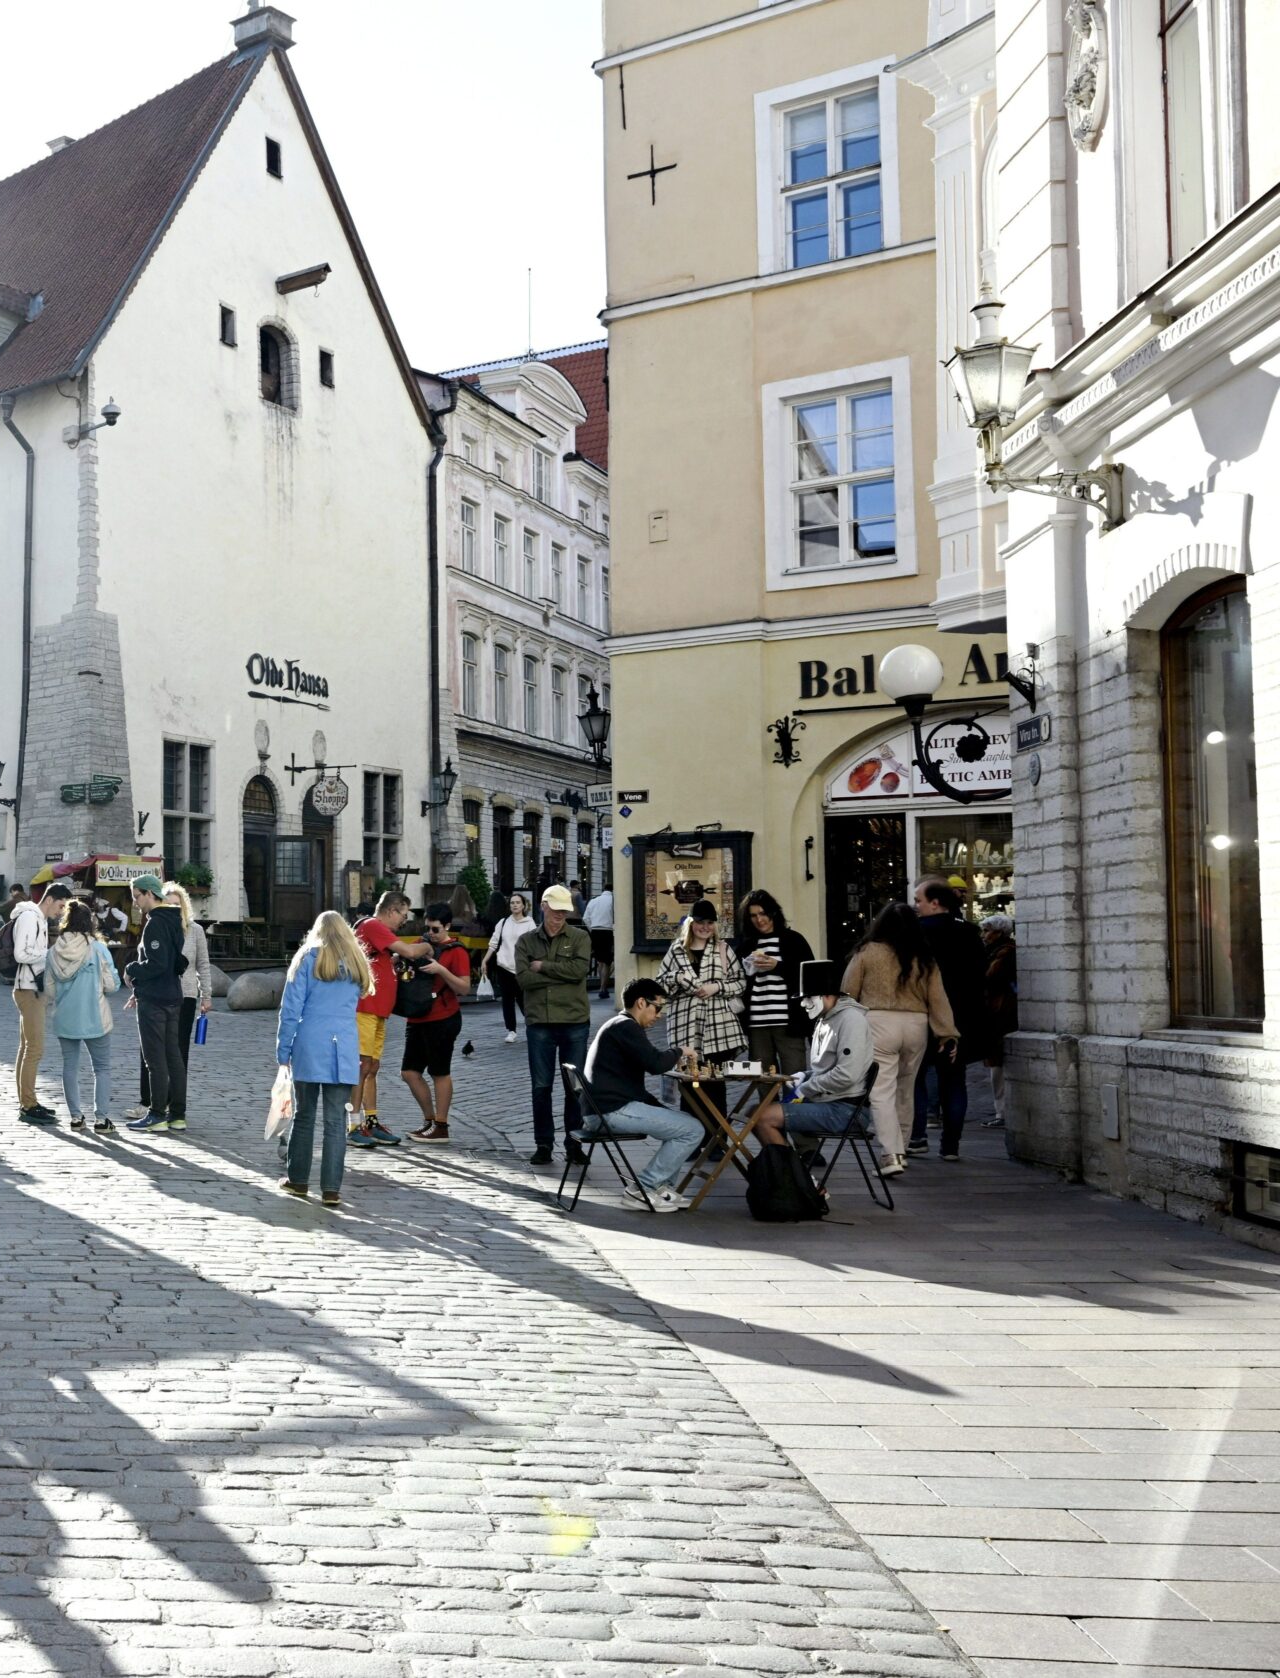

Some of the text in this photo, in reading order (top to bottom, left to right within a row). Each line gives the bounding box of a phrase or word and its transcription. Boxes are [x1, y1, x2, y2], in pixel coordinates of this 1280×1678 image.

[245, 652, 284, 688] Olde
[797, 653, 877, 700] Bal
[1019, 729, 1030, 743] Viru
[977, 769, 1012, 781] AMB
[623, 793, 642, 801] Vene
